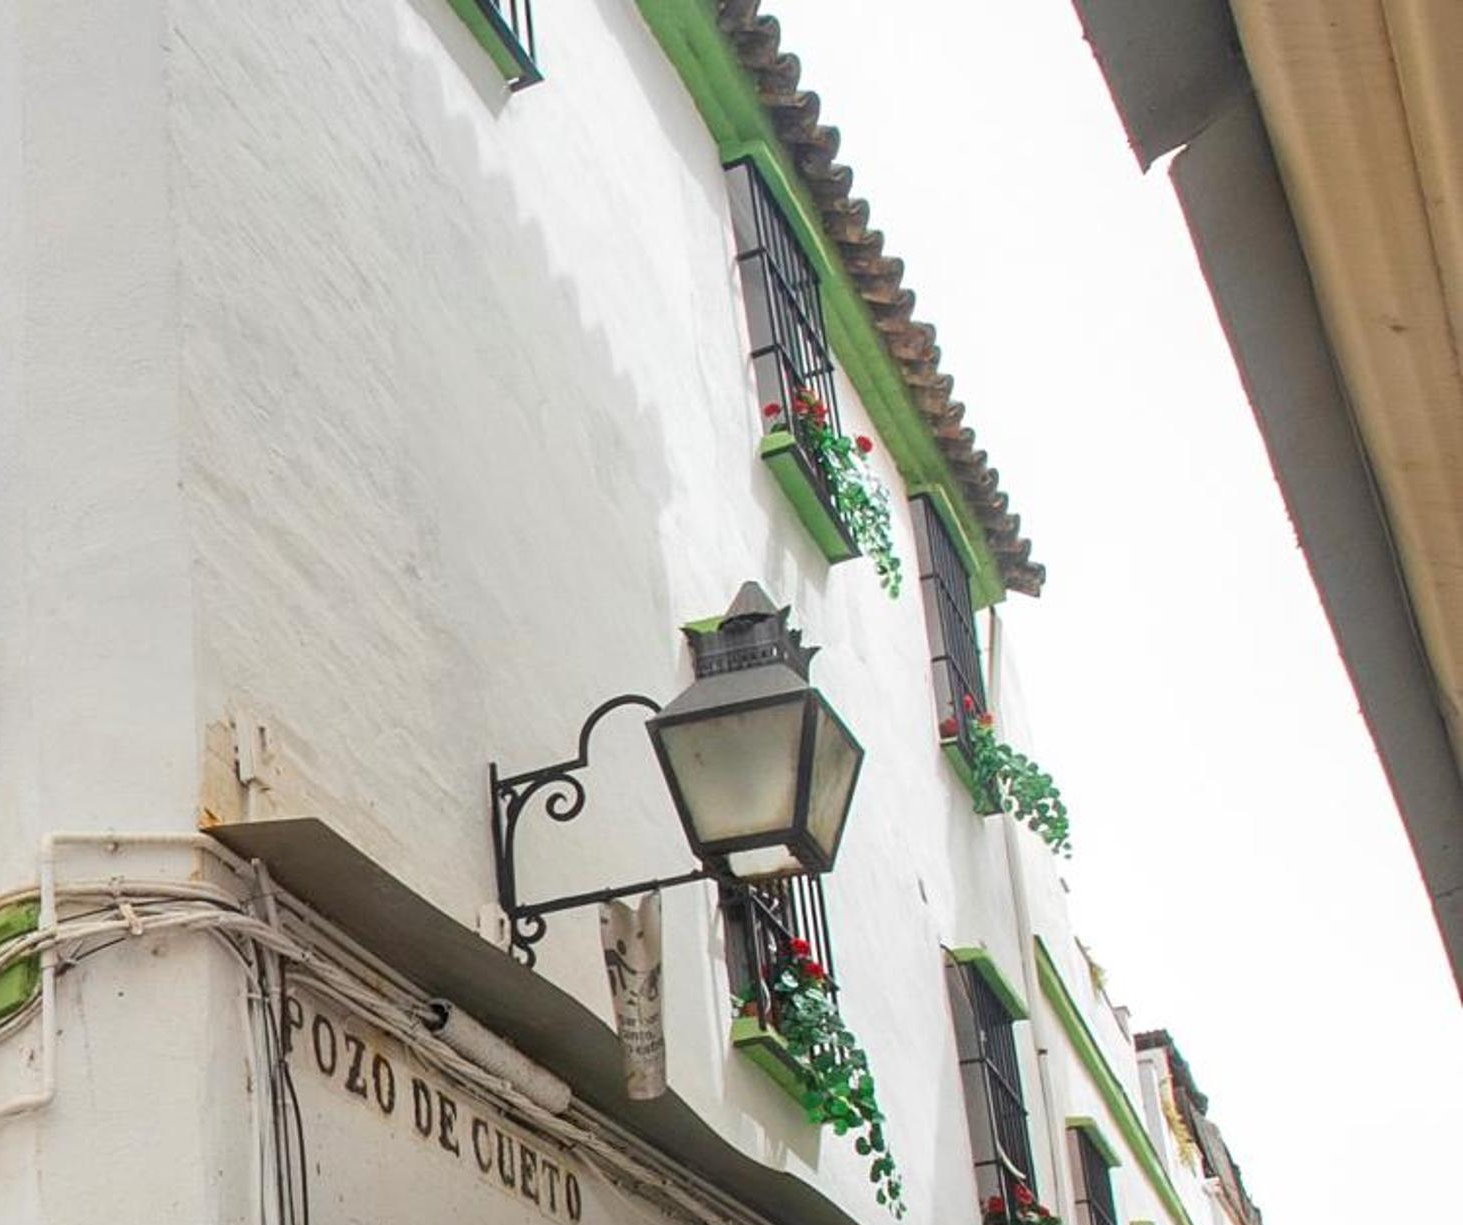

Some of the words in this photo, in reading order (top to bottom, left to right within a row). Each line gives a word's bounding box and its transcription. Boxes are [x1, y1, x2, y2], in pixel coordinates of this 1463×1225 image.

[281, 996, 396, 1115] POZO
[411, 1078, 460, 1158] DE
[471, 1117, 582, 1223] CUETO
